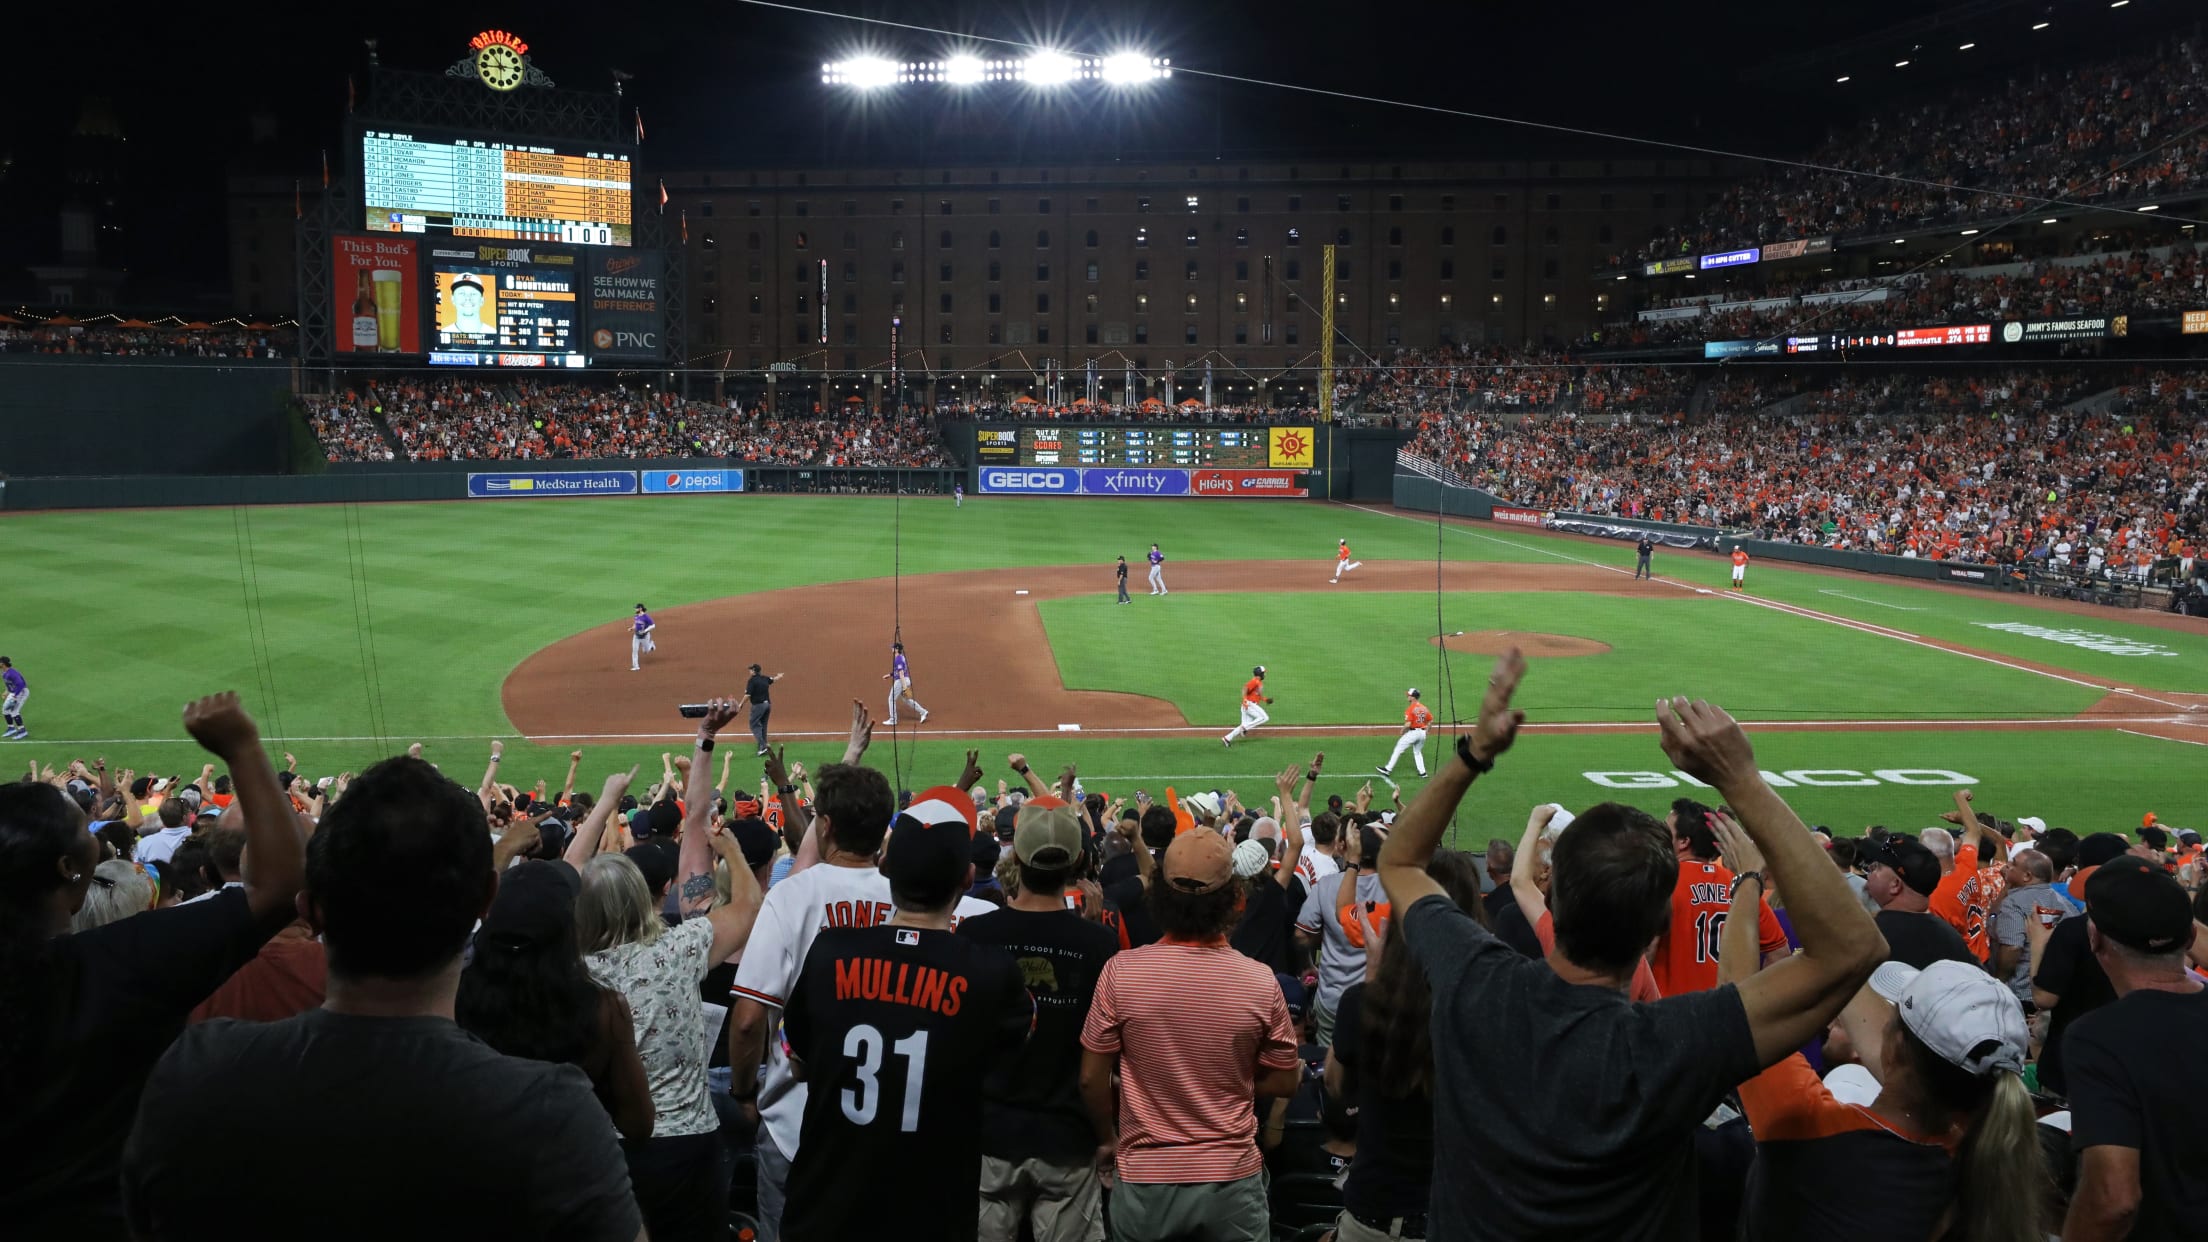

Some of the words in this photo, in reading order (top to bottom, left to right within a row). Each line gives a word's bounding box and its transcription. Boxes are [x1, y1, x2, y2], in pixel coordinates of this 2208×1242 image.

[470, 30, 528, 54] ORIOLES
[569, 228, 572, 241] 1
[584, 228, 590, 242] 0
[600, 229, 606, 243] 0
[341, 240, 372, 252] This
[376, 242, 408, 254] Bud's
[350, 254, 372, 266] For
[374, 256, 402, 268] You.
[479, 246, 530, 264] SUPERBOOK
[516, 282, 568, 292] MOUNTCASTLE
[594, 276, 613, 286] SEE
[615, 278, 638, 287] HOW
[640, 279, 656, 288] WE
[594, 288, 614, 298] CAN
[617, 290, 645, 299] MAKE
[648, 291, 654, 300] A
[593, 300, 656, 311] DIFFERENCE
[2185, 313, 2206, 322] NEED
[2026, 322, 2050, 332] JIMMY'S
[2052, 321, 2076, 331] FAMOUS
[2077, 319, 2104, 329] SEAFOOD
[616, 332, 656, 348] PNC
[1859, 337, 1863, 347] 1
[1872, 336, 1878, 346] 0
[1887, 335, 1894, 345] 0
[1946, 335, 1962, 343] .274
[485, 356, 494, 364] 2
[978, 430, 1016, 442] SUPERBOOK
[1034, 441, 1062, 450] SCORES
[536, 479, 581, 490] MedStar
[583, 478, 620, 488] Health
[685, 474, 721, 489] pepsi
[988, 473, 1064, 488] GEICO
[1104, 471, 1166, 492] xfinity
[1200, 479, 1233, 492] HIGH'S
[1494, 510, 1508, 520] weis
[1509, 512, 1538, 522] markets
[769, 812, 778, 826] 4
[1690, 882, 1733, 906] JONE
[822, 900, 897, 930] JONE
[1024, 946, 1053, 954] GOODS
[1058, 949, 1083, 960] SINCE
[835, 956, 968, 1016] MULLINS
[840, 1024, 929, 1132] 31
